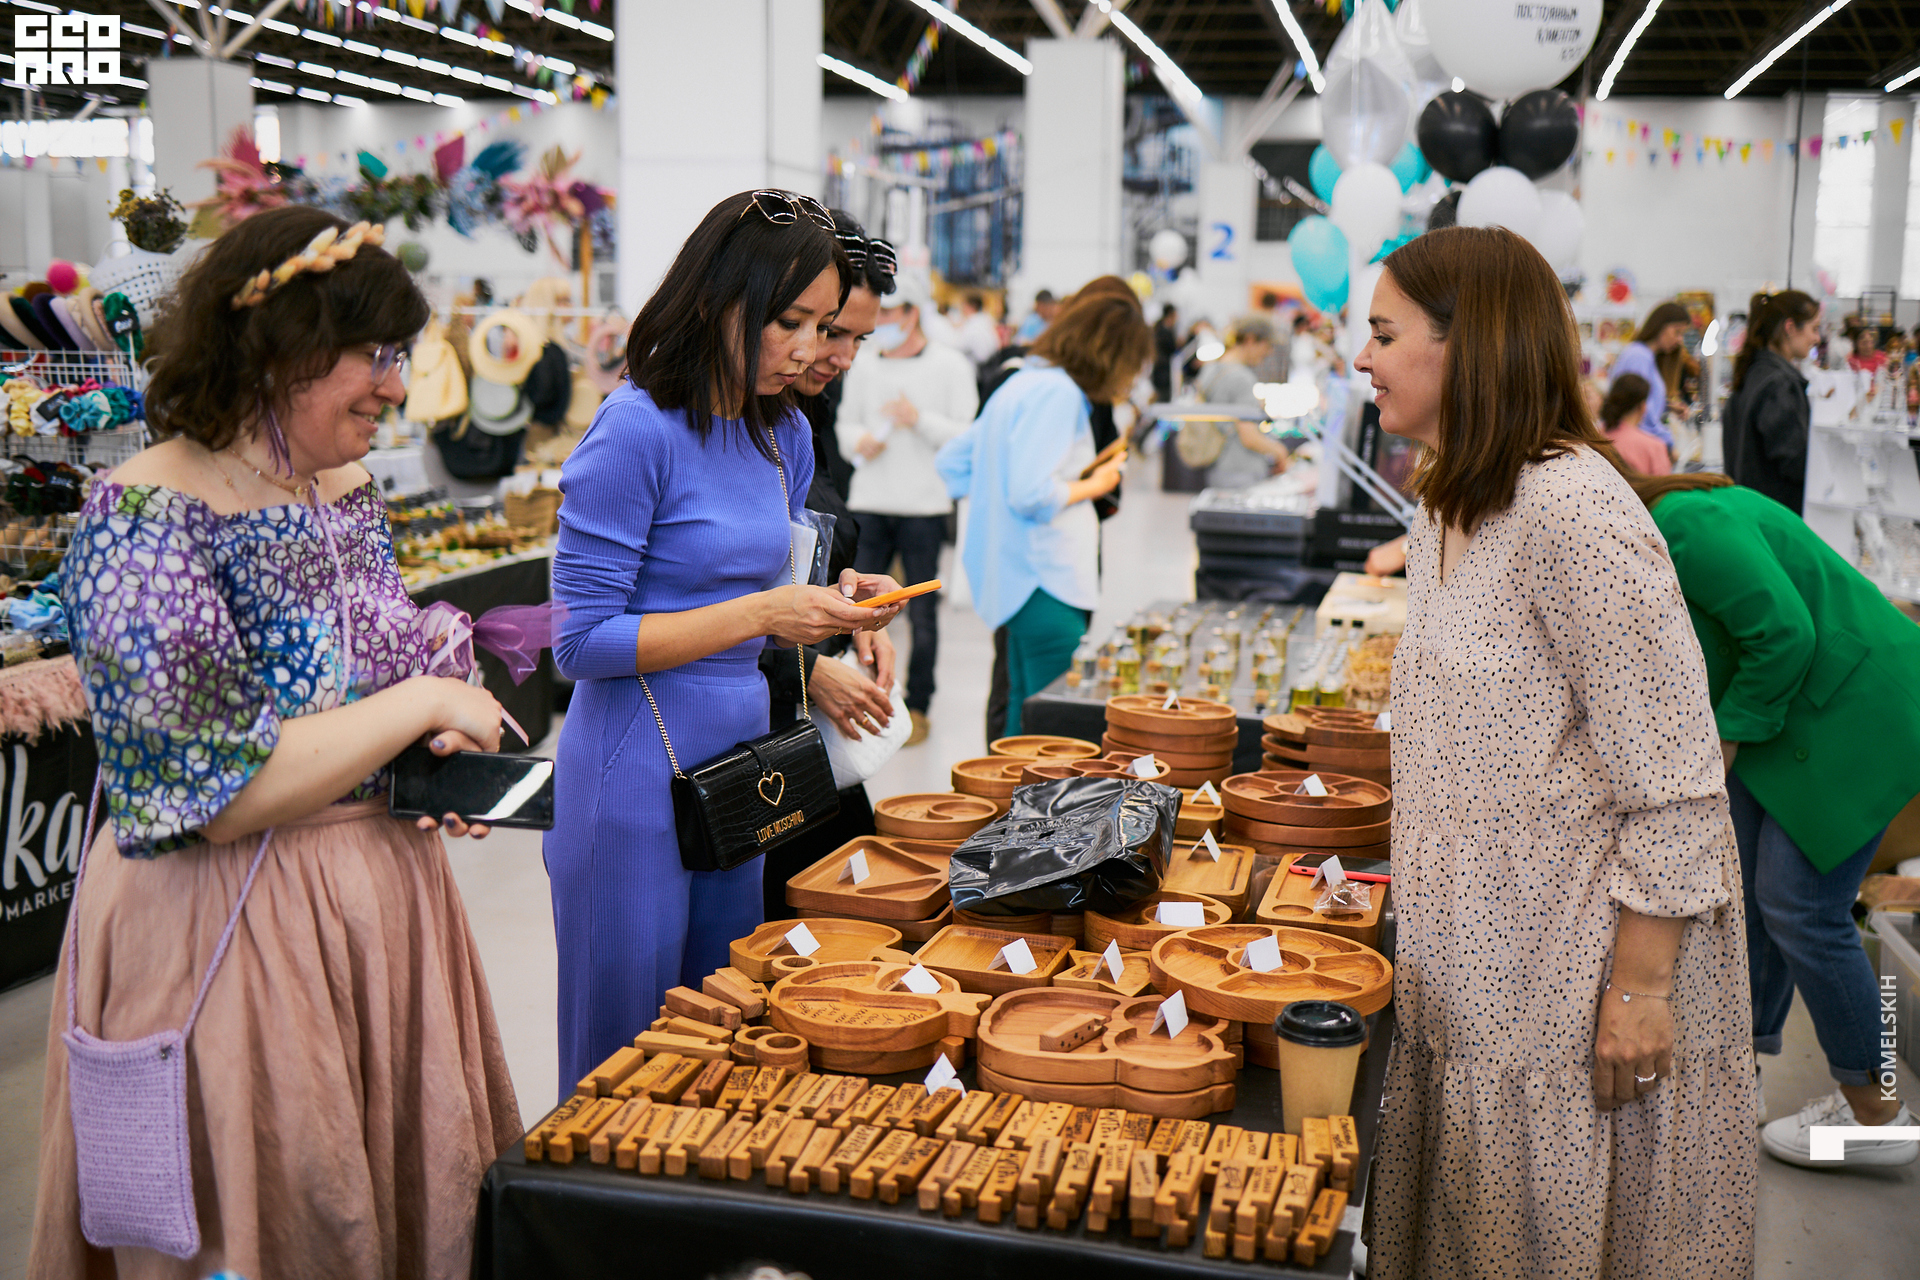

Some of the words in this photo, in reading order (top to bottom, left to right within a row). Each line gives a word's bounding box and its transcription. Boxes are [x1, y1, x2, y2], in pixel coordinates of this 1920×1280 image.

[1211, 222, 1234, 260] 2
[0, 744, 84, 890] ka
[757, 825, 775, 843] LOVE
[773, 810, 804, 835] MOSCHINO
[5, 878, 77, 921] MARKE
